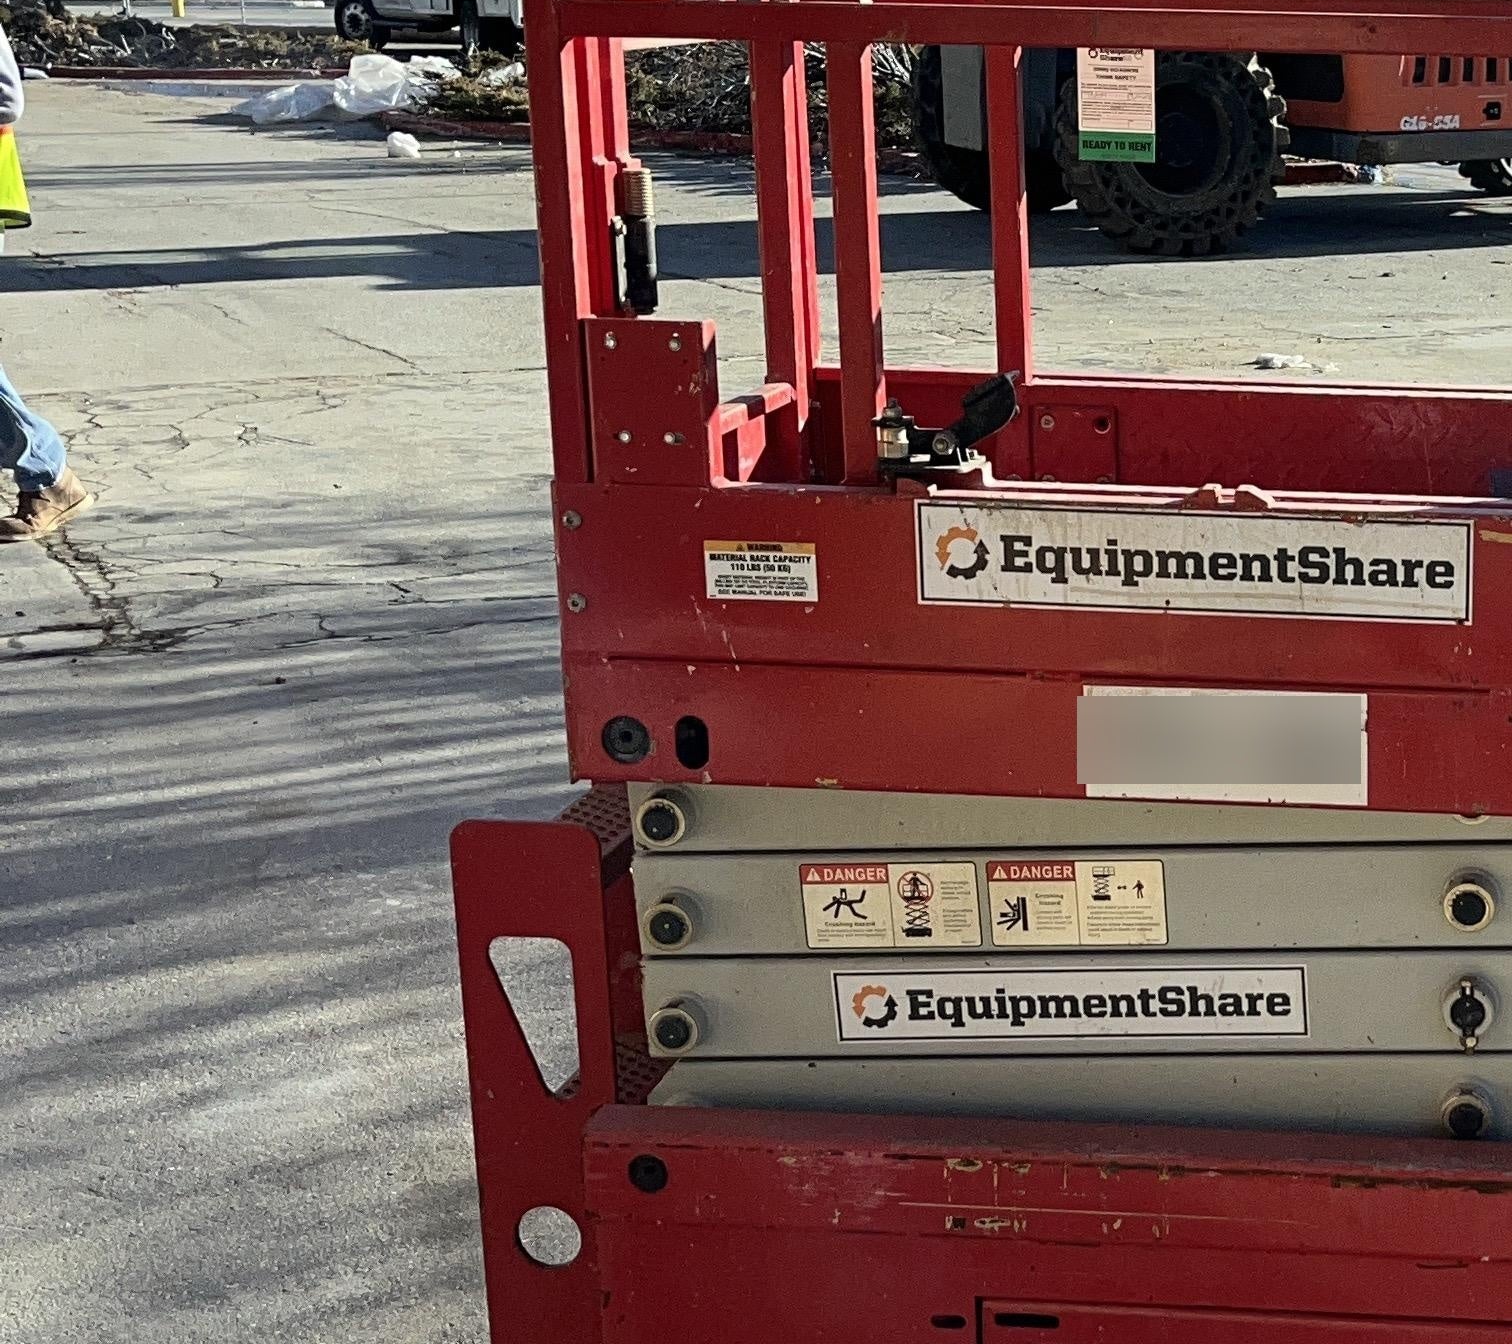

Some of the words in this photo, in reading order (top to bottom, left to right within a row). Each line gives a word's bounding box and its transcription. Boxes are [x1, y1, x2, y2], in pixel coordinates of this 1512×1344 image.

[1082, 140, 1112, 150] READY
[1115, 141, 1126, 150] TO
[1128, 142, 1152, 152] RENT
[746, 543, 784, 552] WARNING
[709, 553, 748, 562] MATERIAL
[749, 554, 771, 562] RACK
[773, 555, 811, 564] CAPACITY
[998, 533, 1457, 591] EquipmentShare
[730, 563, 745, 571] 110
[746, 564, 761, 572] LBS
[823, 867, 887, 882] DANGER
[1009, 865, 1074, 879] DANGER
[905, 984, 1292, 1030] EquipmentShare
